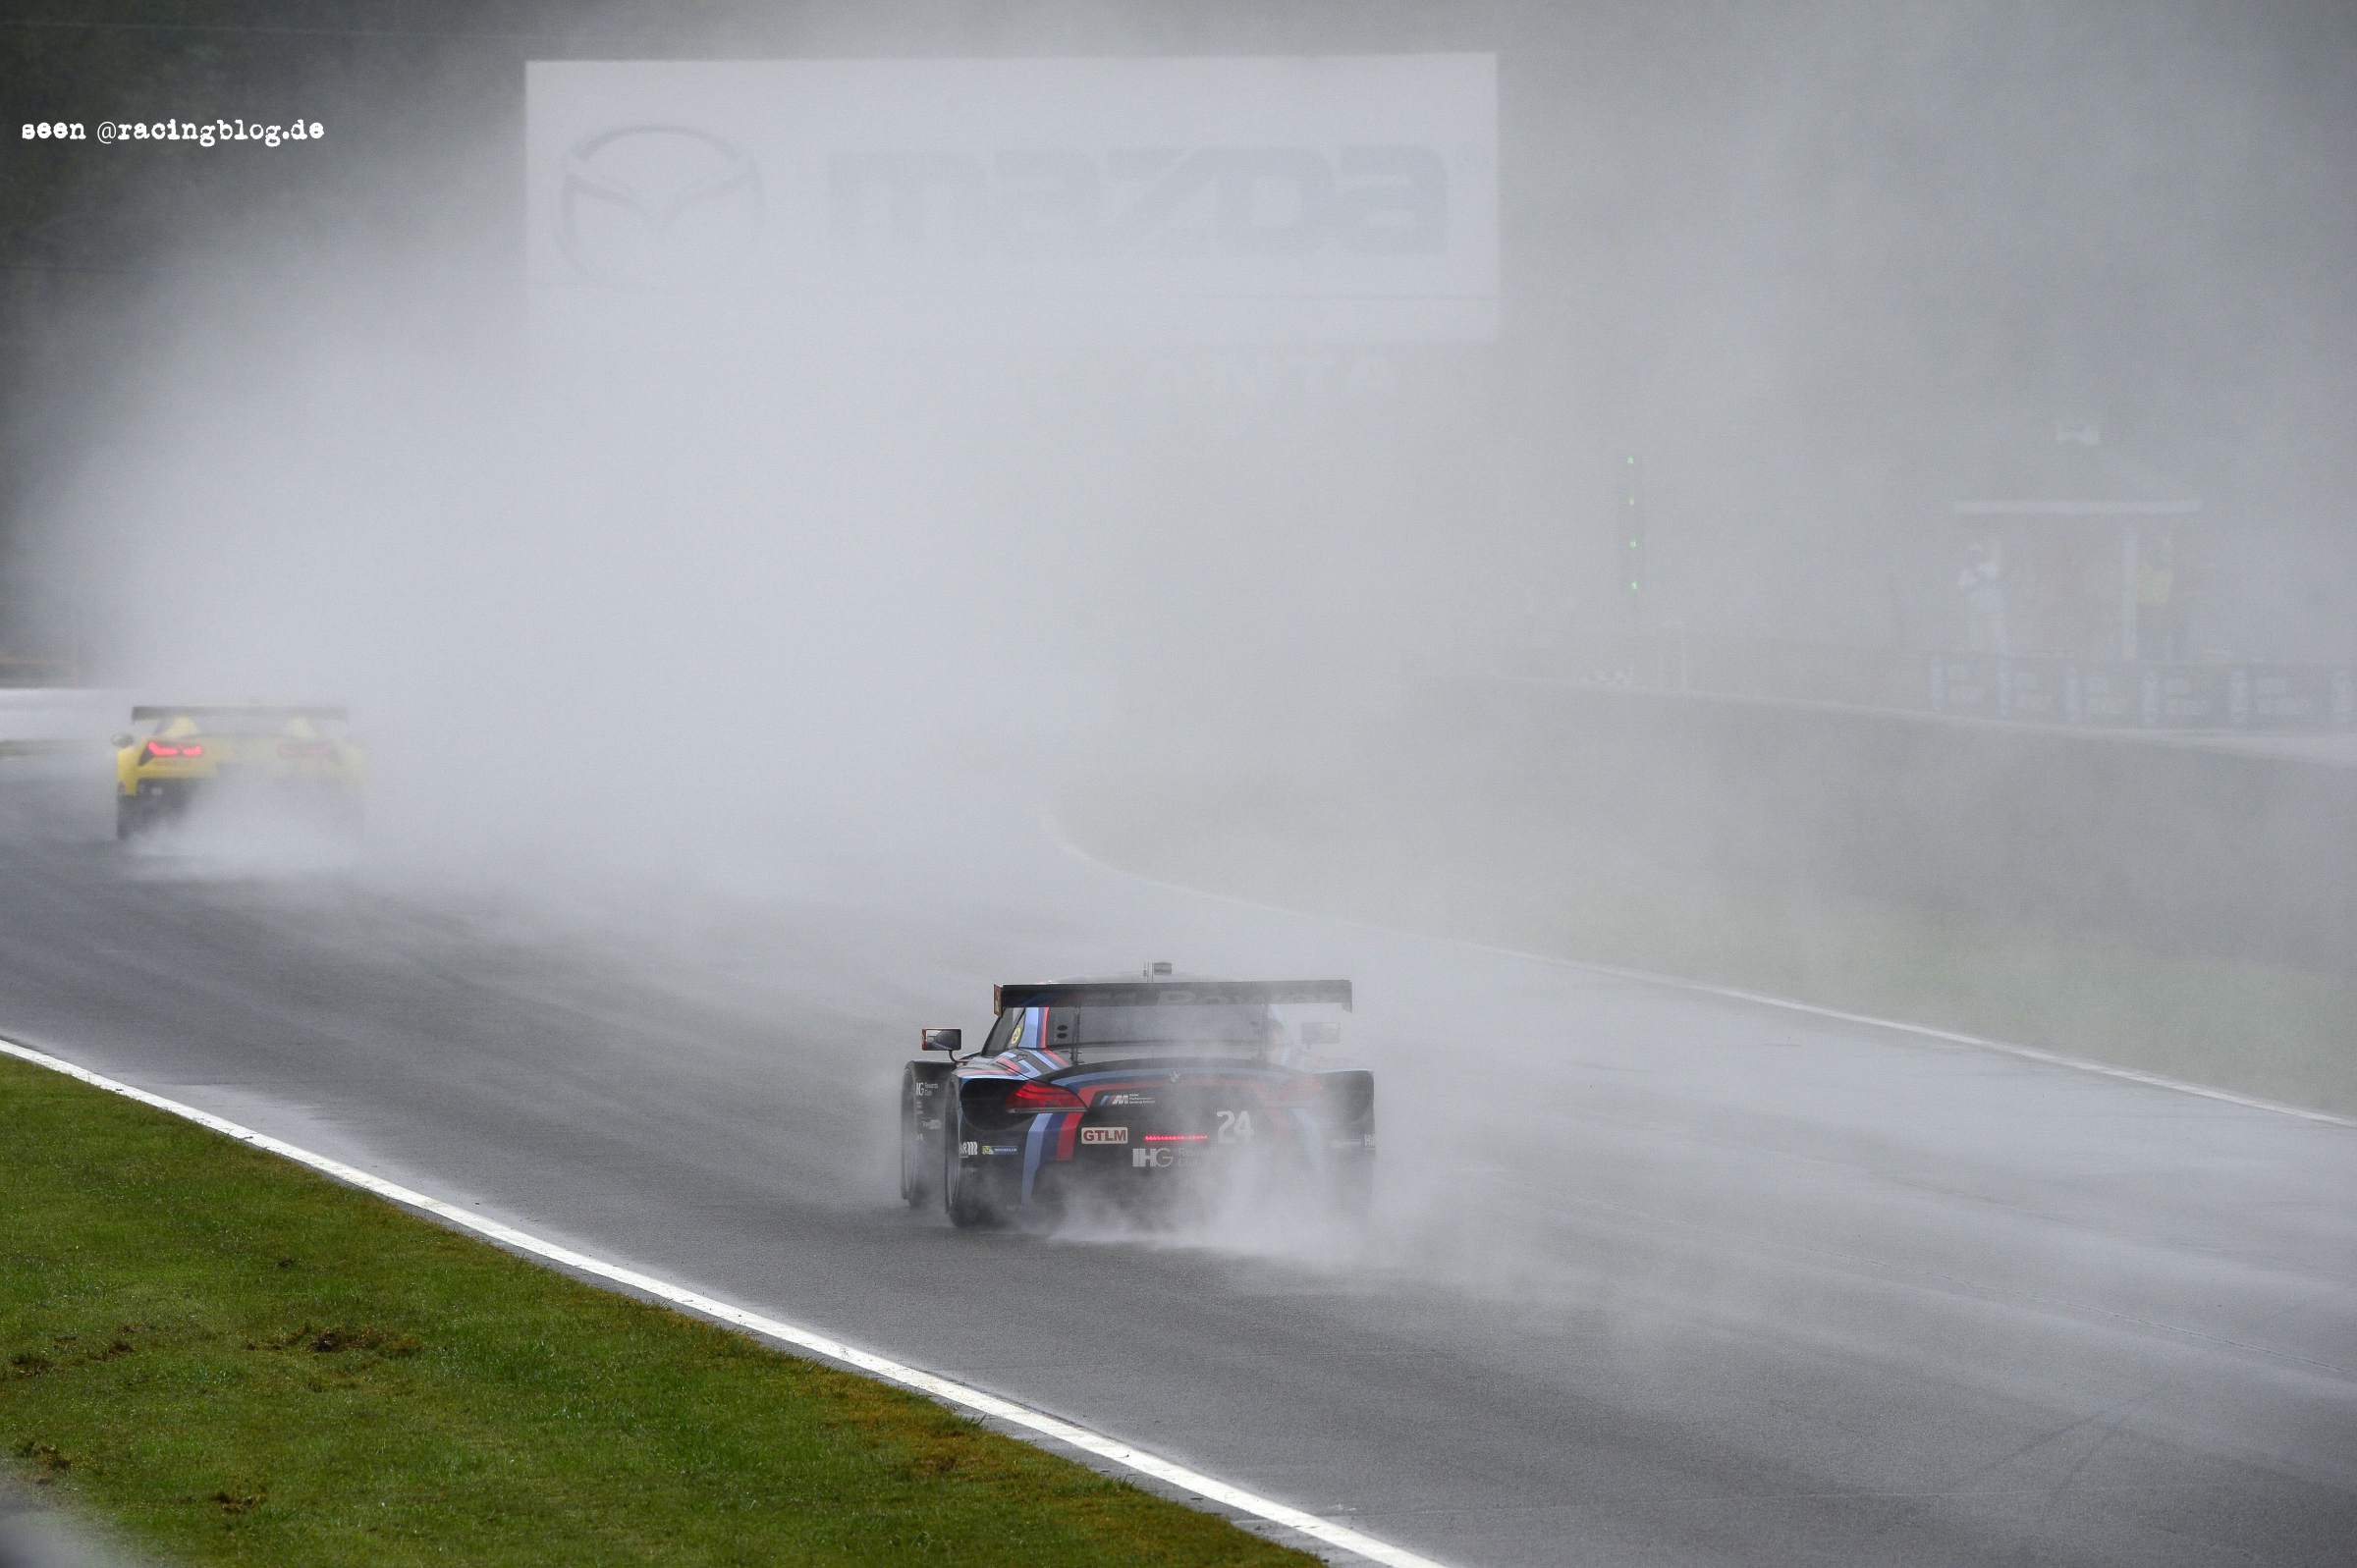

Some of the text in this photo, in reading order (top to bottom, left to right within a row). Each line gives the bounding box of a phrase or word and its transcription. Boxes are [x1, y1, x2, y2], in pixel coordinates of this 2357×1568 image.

[1083, 1129, 1126, 1142] GTLM
[1216, 1109, 1255, 1144] 24
[1132, 1147, 1174, 1167] IHG
